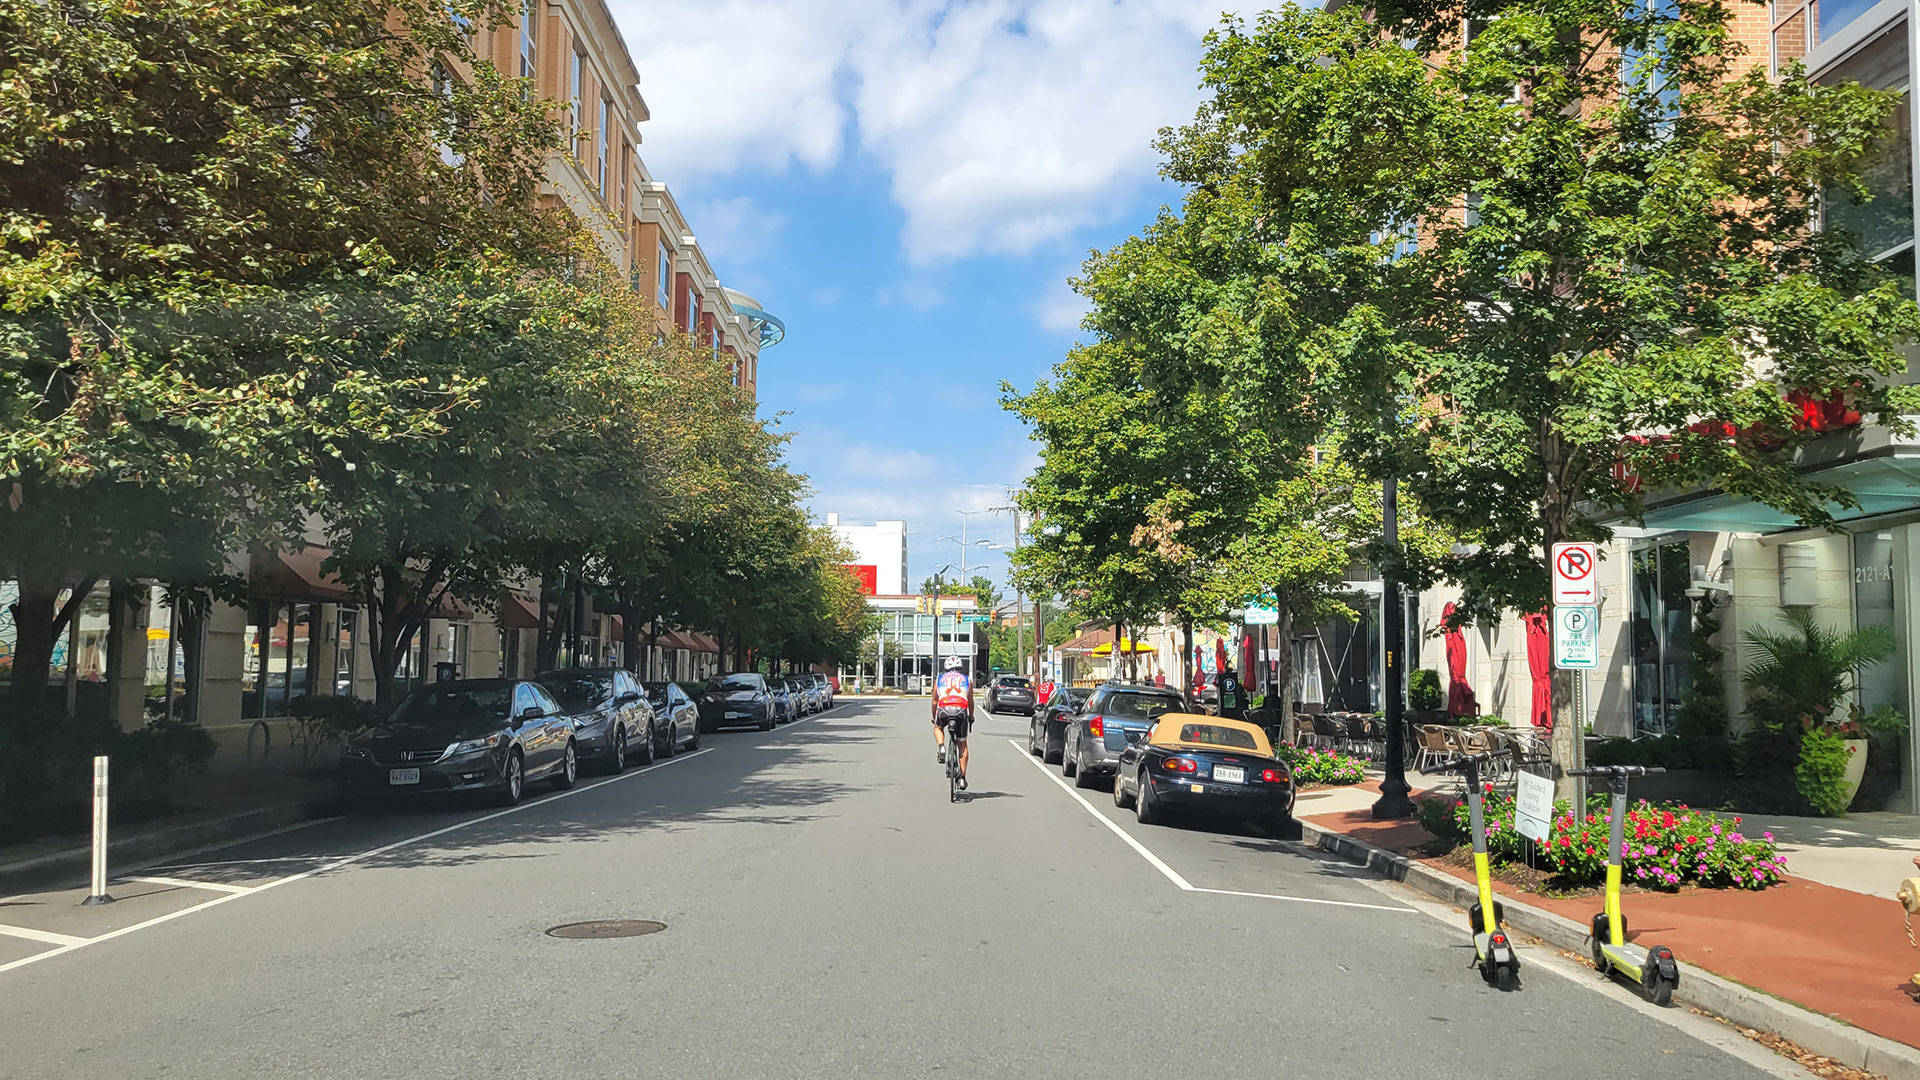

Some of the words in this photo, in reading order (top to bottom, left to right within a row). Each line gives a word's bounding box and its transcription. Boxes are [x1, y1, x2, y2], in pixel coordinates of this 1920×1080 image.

[1569, 632, 1583, 640] PAY
[1561, 639, 1591, 647] PARKING
[1567, 647, 1574, 658] 2
